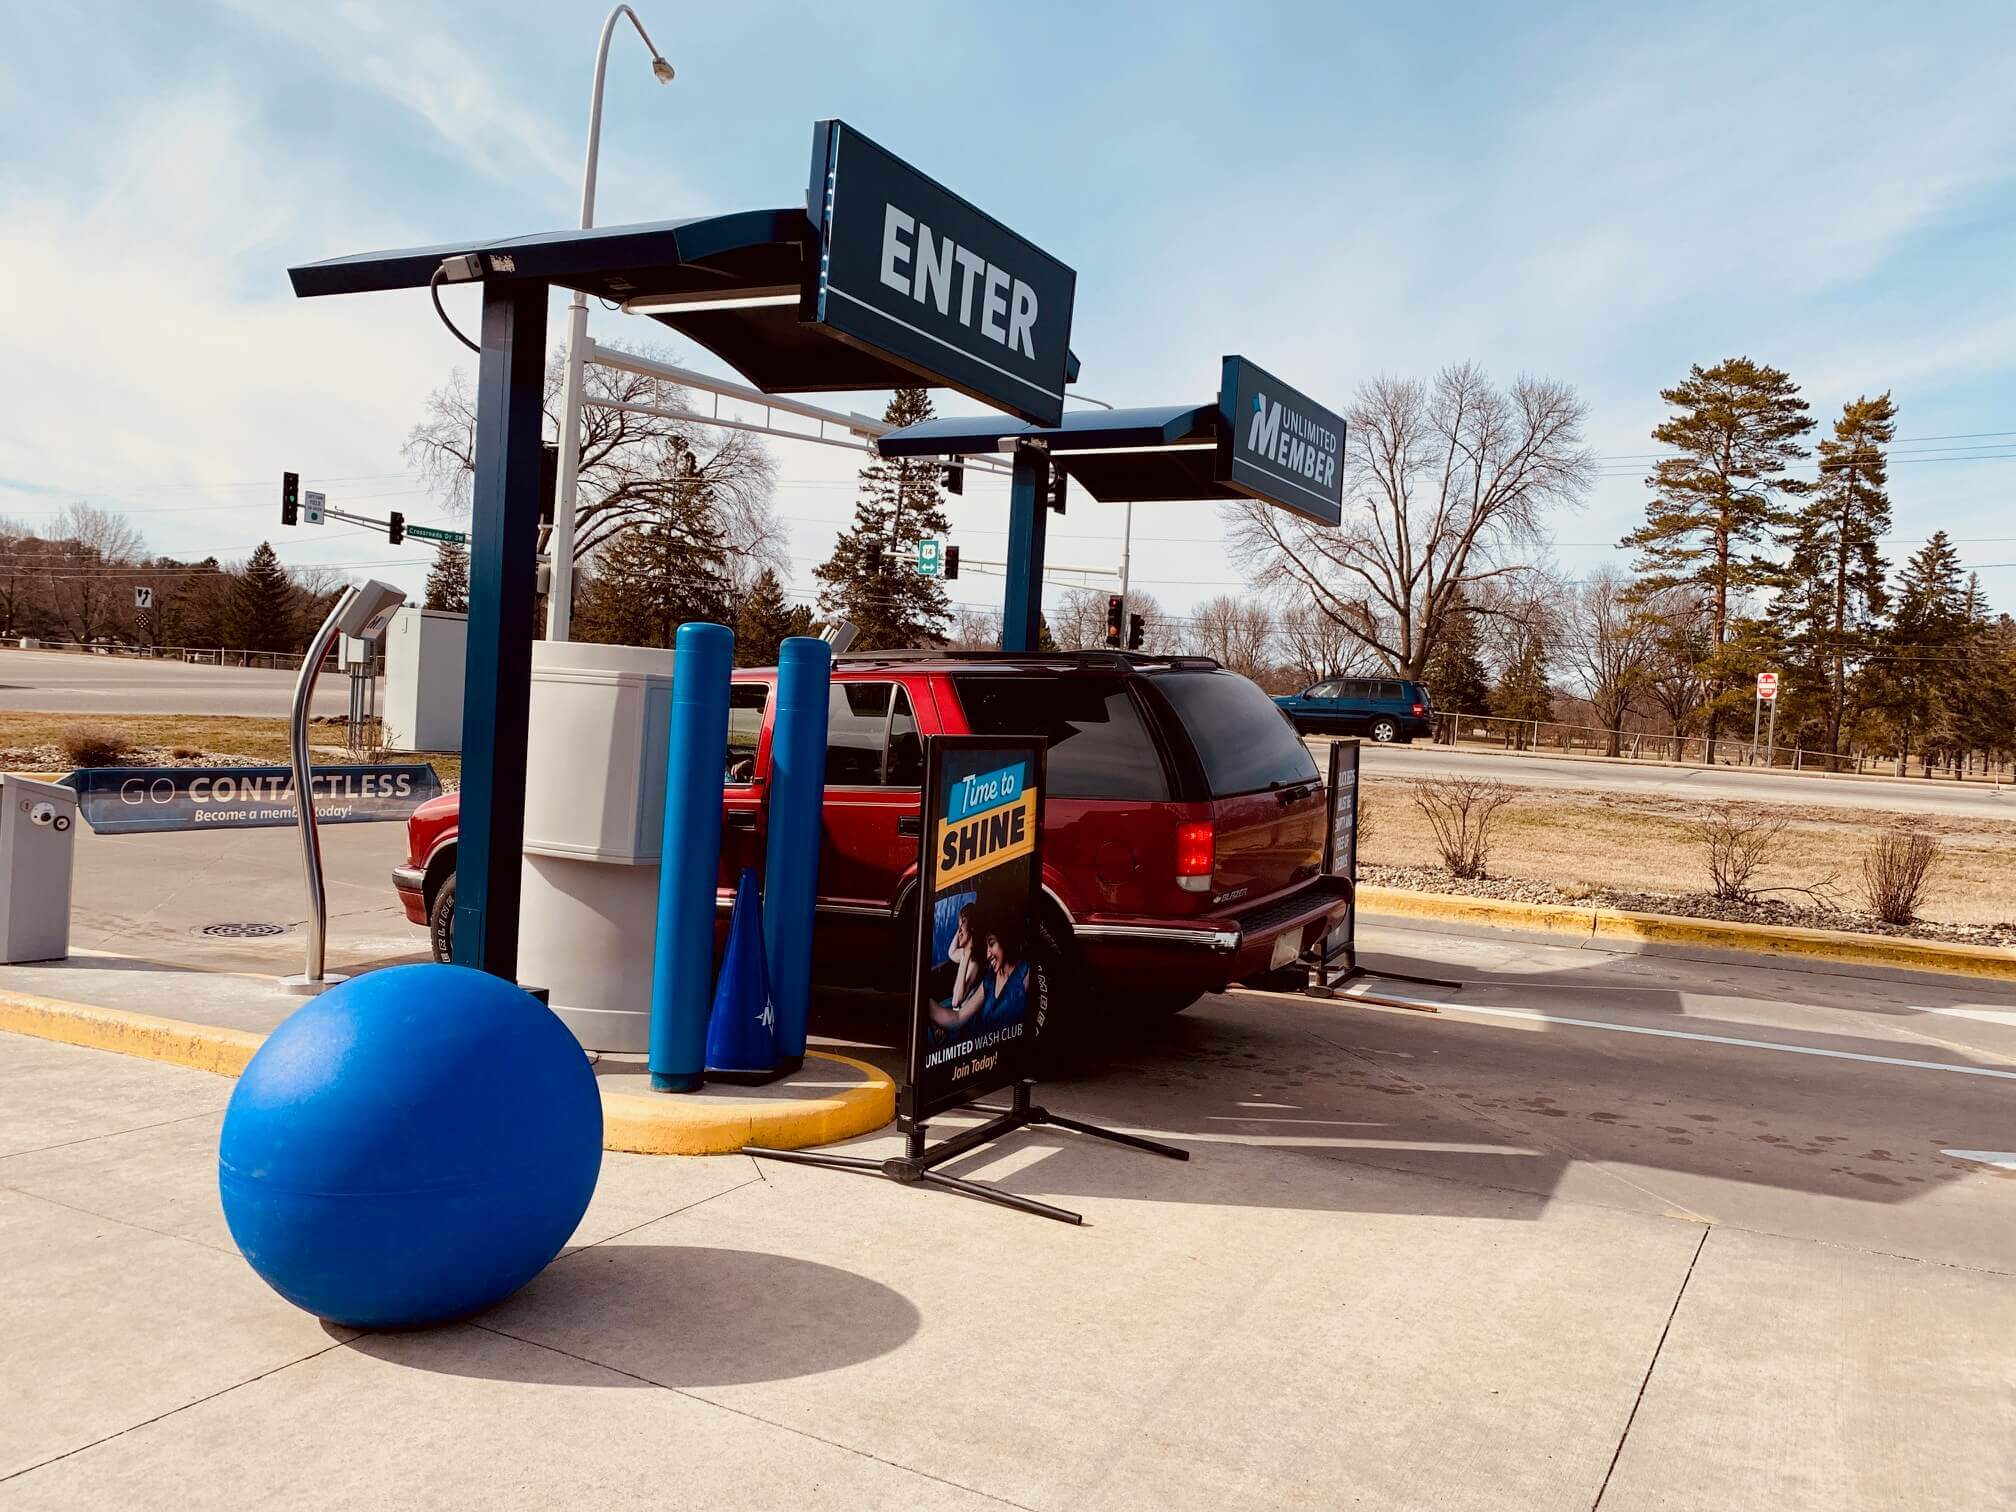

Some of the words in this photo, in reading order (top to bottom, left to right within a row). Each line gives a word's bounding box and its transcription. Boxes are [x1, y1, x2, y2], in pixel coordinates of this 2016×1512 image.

[880, 202, 1038, 361] ENTER
[1248, 392, 1335, 489] MEMBER
[1282, 406, 1337, 454] UNLIMITED
[409, 528, 442, 539] Crossroads
[120, 777, 175, 804] GO
[962, 774, 998, 813] Time
[1001, 771, 1015, 796] to
[194, 809, 246, 822] Become
[249, 810, 257, 819] a
[260, 807, 299, 820] memb
[315, 805, 352, 818] today!
[941, 805, 1026, 871] SHINE
[925, 1040, 973, 1069] UNLIMITED
[974, 1030, 1000, 1050] WASH
[1001, 1023, 1023, 1041] CLUB
[951, 1062, 970, 1080] Join
[971, 1050, 998, 1073] Today!
